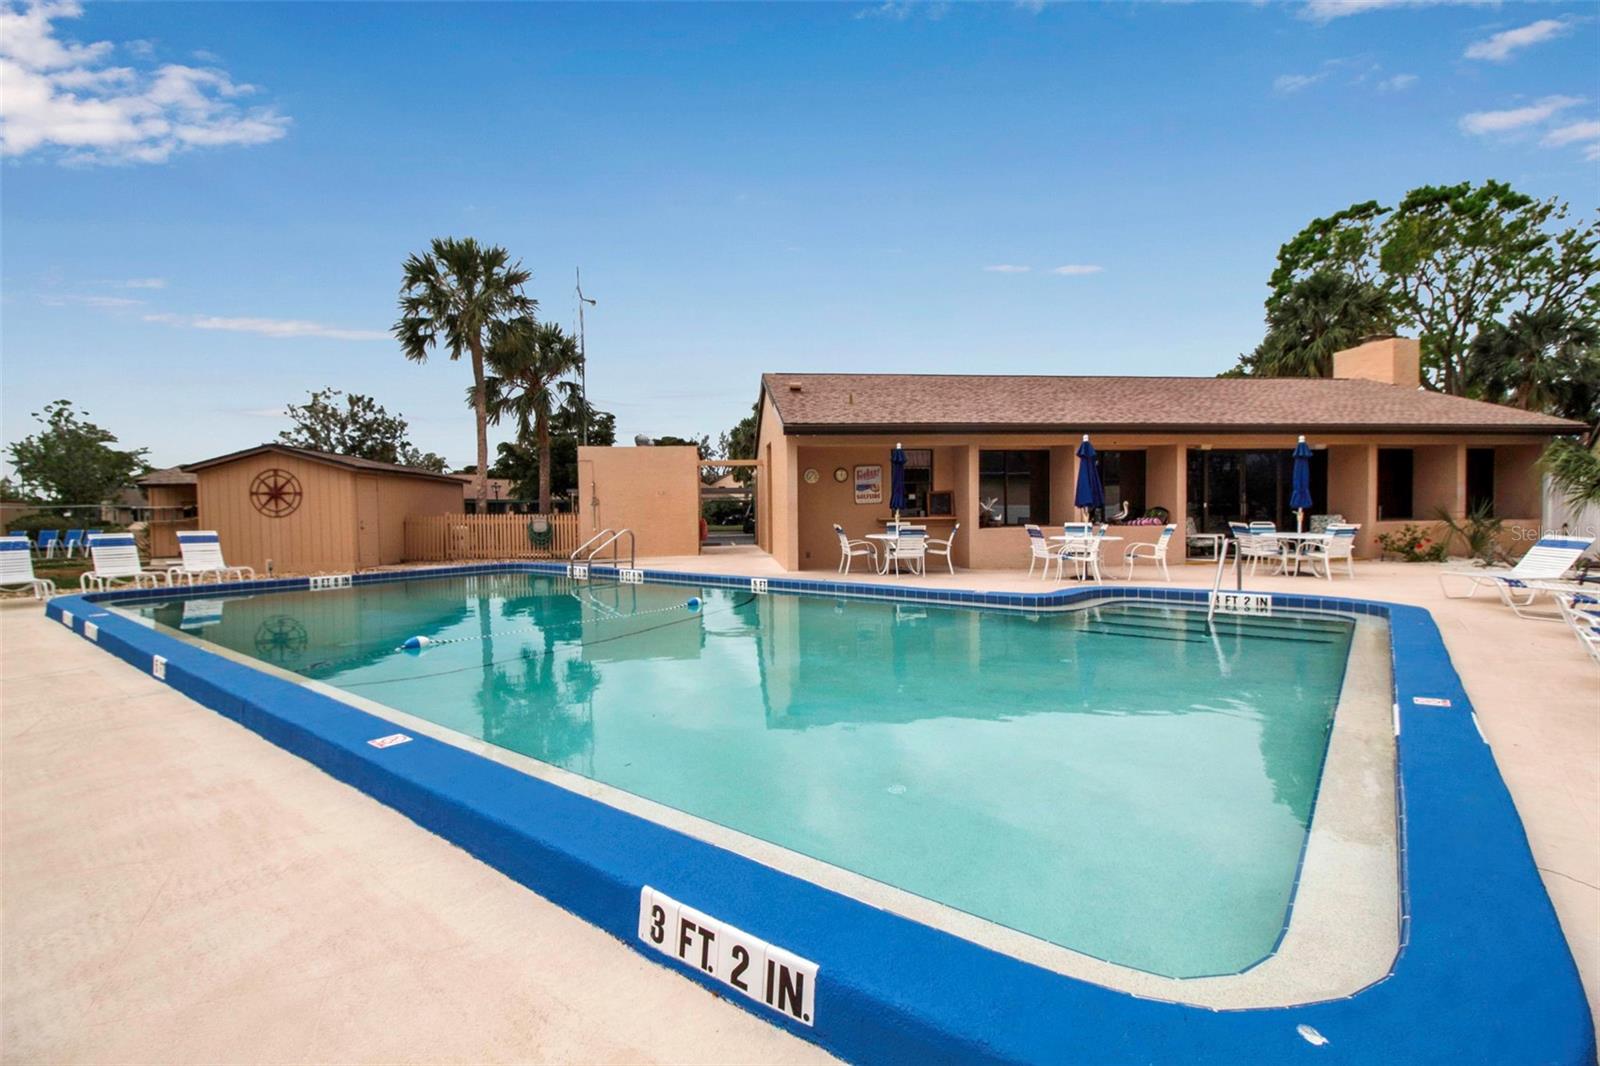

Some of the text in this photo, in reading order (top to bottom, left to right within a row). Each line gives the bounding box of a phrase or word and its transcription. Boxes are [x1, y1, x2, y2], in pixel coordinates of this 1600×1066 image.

[1225, 595, 1238, 605] FT
[1244, 596, 1251, 605] 2
[1256, 597, 1268, 606] IN
[650, 904, 810, 1022] 3 FT. 2 IN.
